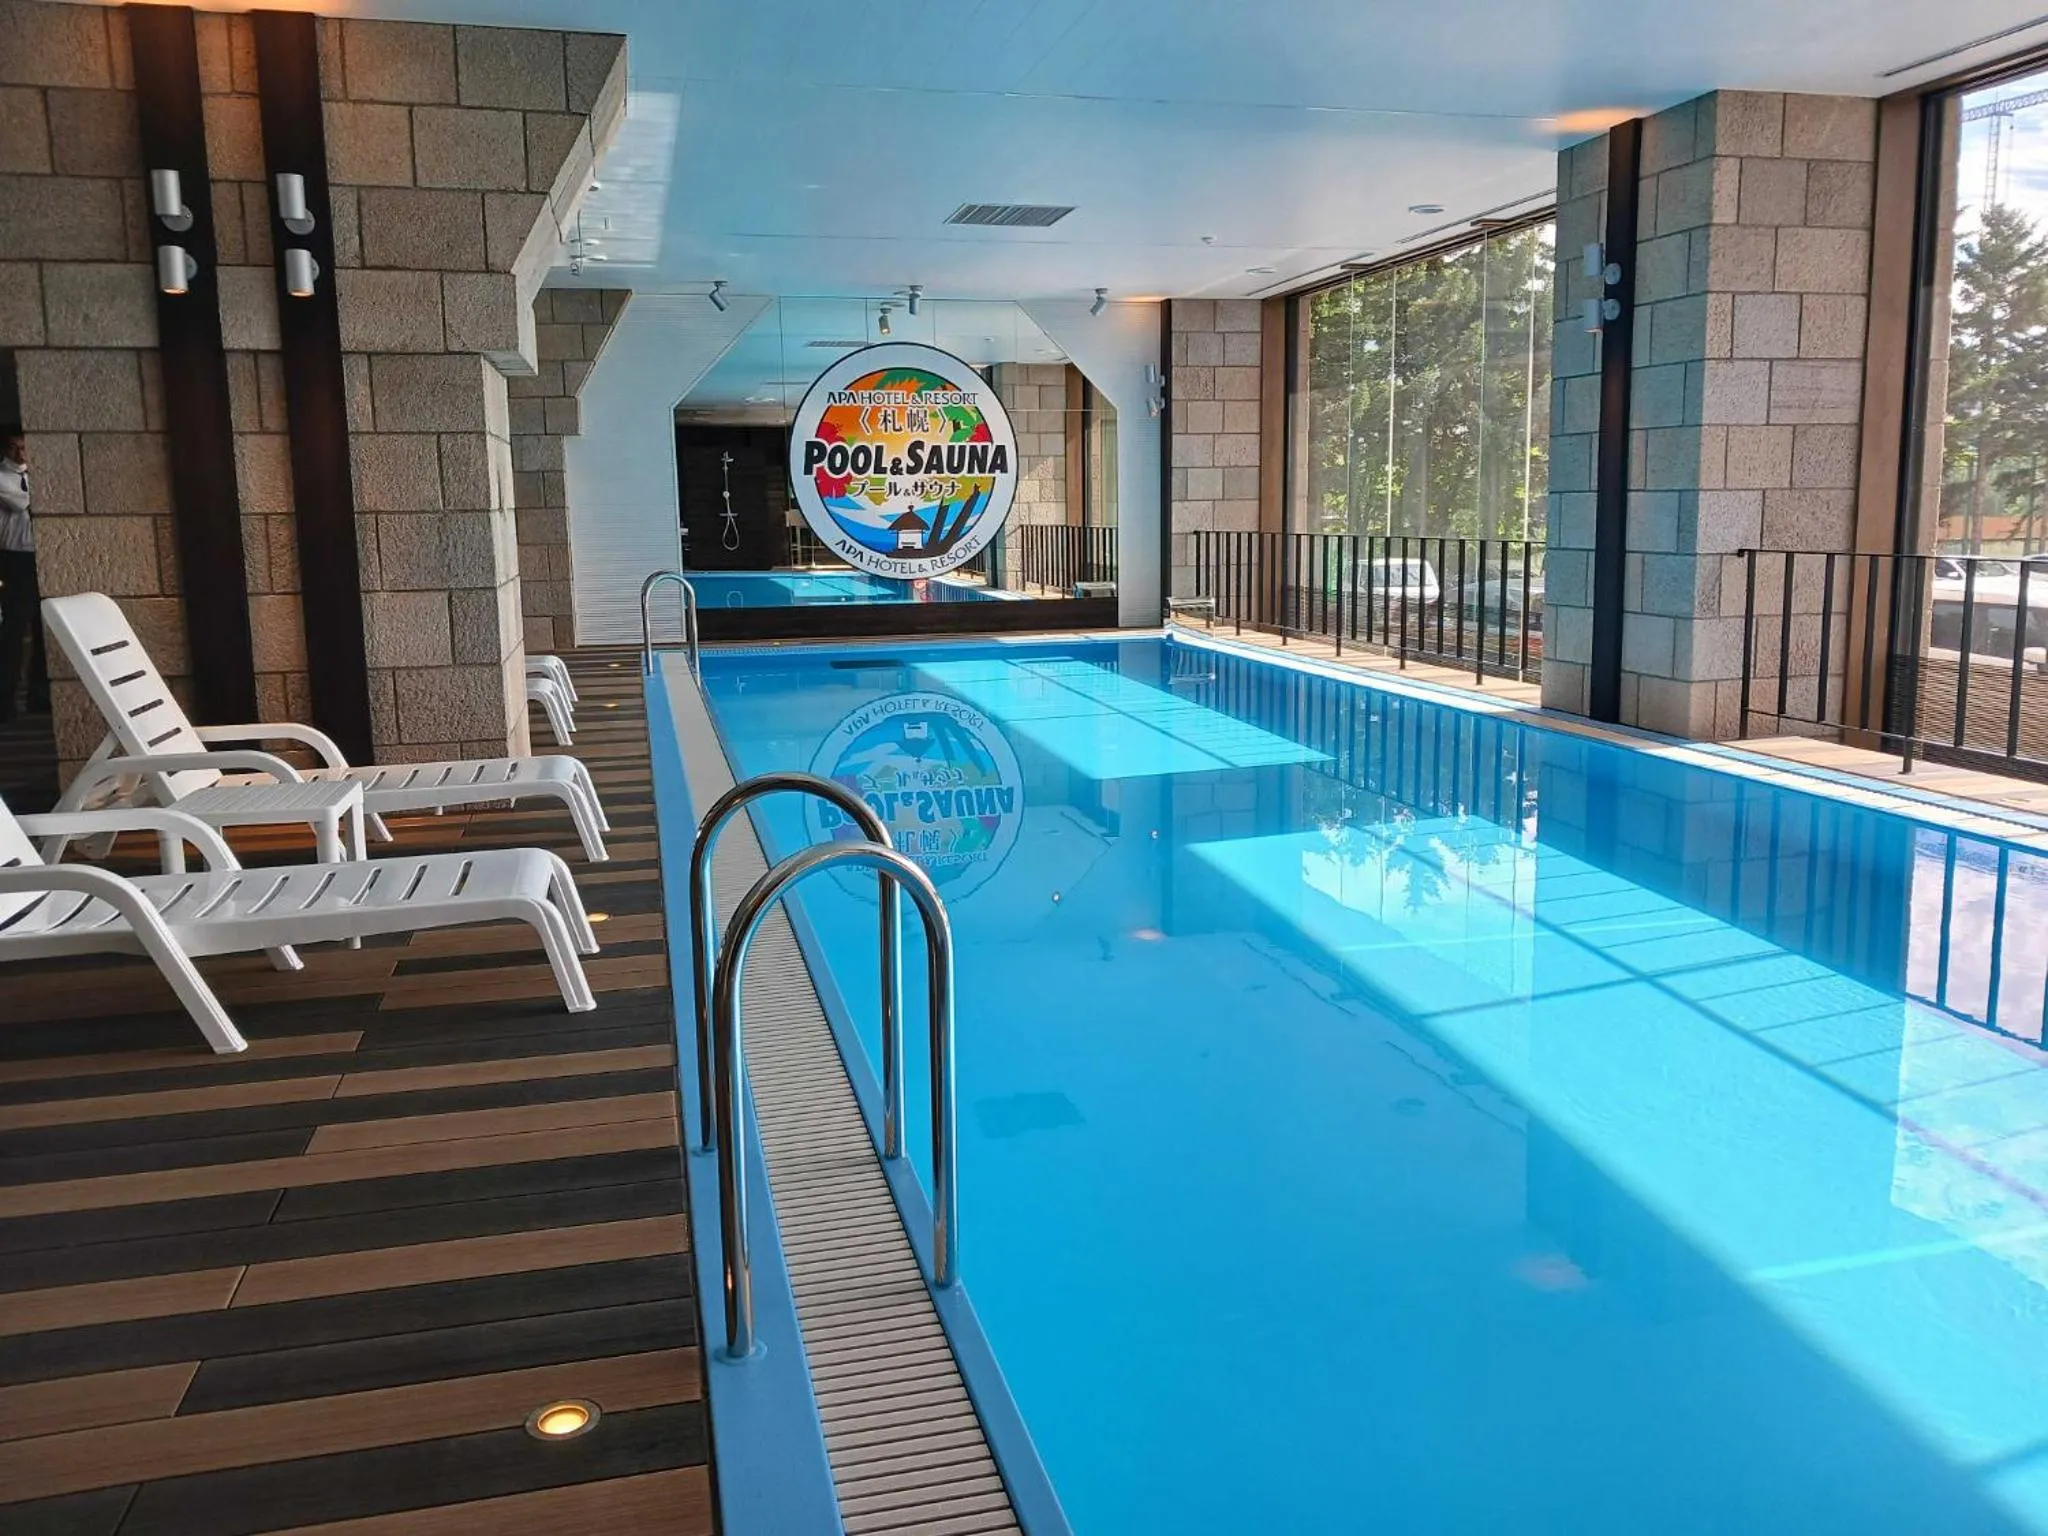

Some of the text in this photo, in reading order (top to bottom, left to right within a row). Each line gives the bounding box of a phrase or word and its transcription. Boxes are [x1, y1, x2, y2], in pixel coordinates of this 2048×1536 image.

[826, 391, 858, 405] APA
[860, 391, 905, 405] HOTEL
[923, 391, 978, 405] RESORT
[835, 539, 864, 563] APA
[866, 555, 915, 574] HOTEL
[930, 535, 982, 571] RESORT
